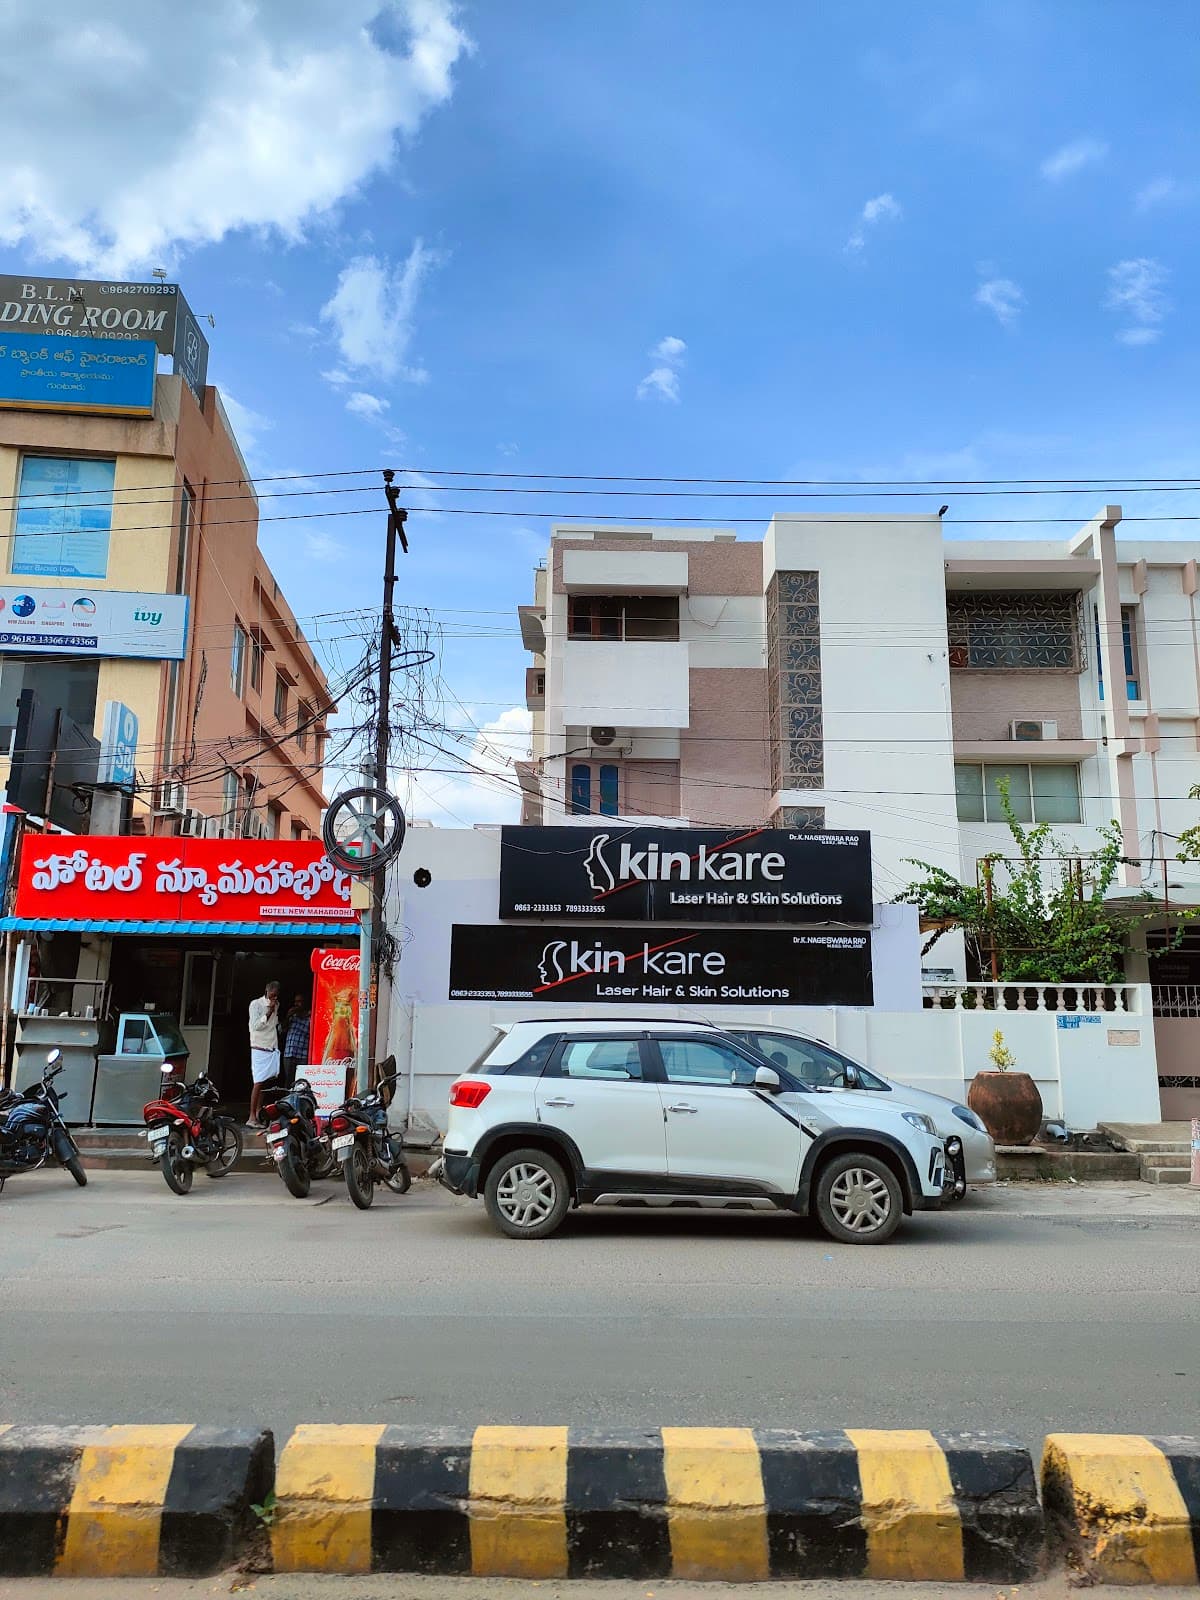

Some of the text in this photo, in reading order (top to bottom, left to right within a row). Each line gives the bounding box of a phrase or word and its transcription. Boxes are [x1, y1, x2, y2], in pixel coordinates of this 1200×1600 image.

[109, 286, 176, 294] 9642709293
[80, 306, 168, 331] ROOM
[134, 607, 162, 625] ivy
[698, 844, 786, 881] kare
[669, 892, 842, 905] Laser Hair & Skin Solutions
[643, 942, 726, 976] kare
[596, 984, 790, 998] Laser Hair & Skin Solutions
